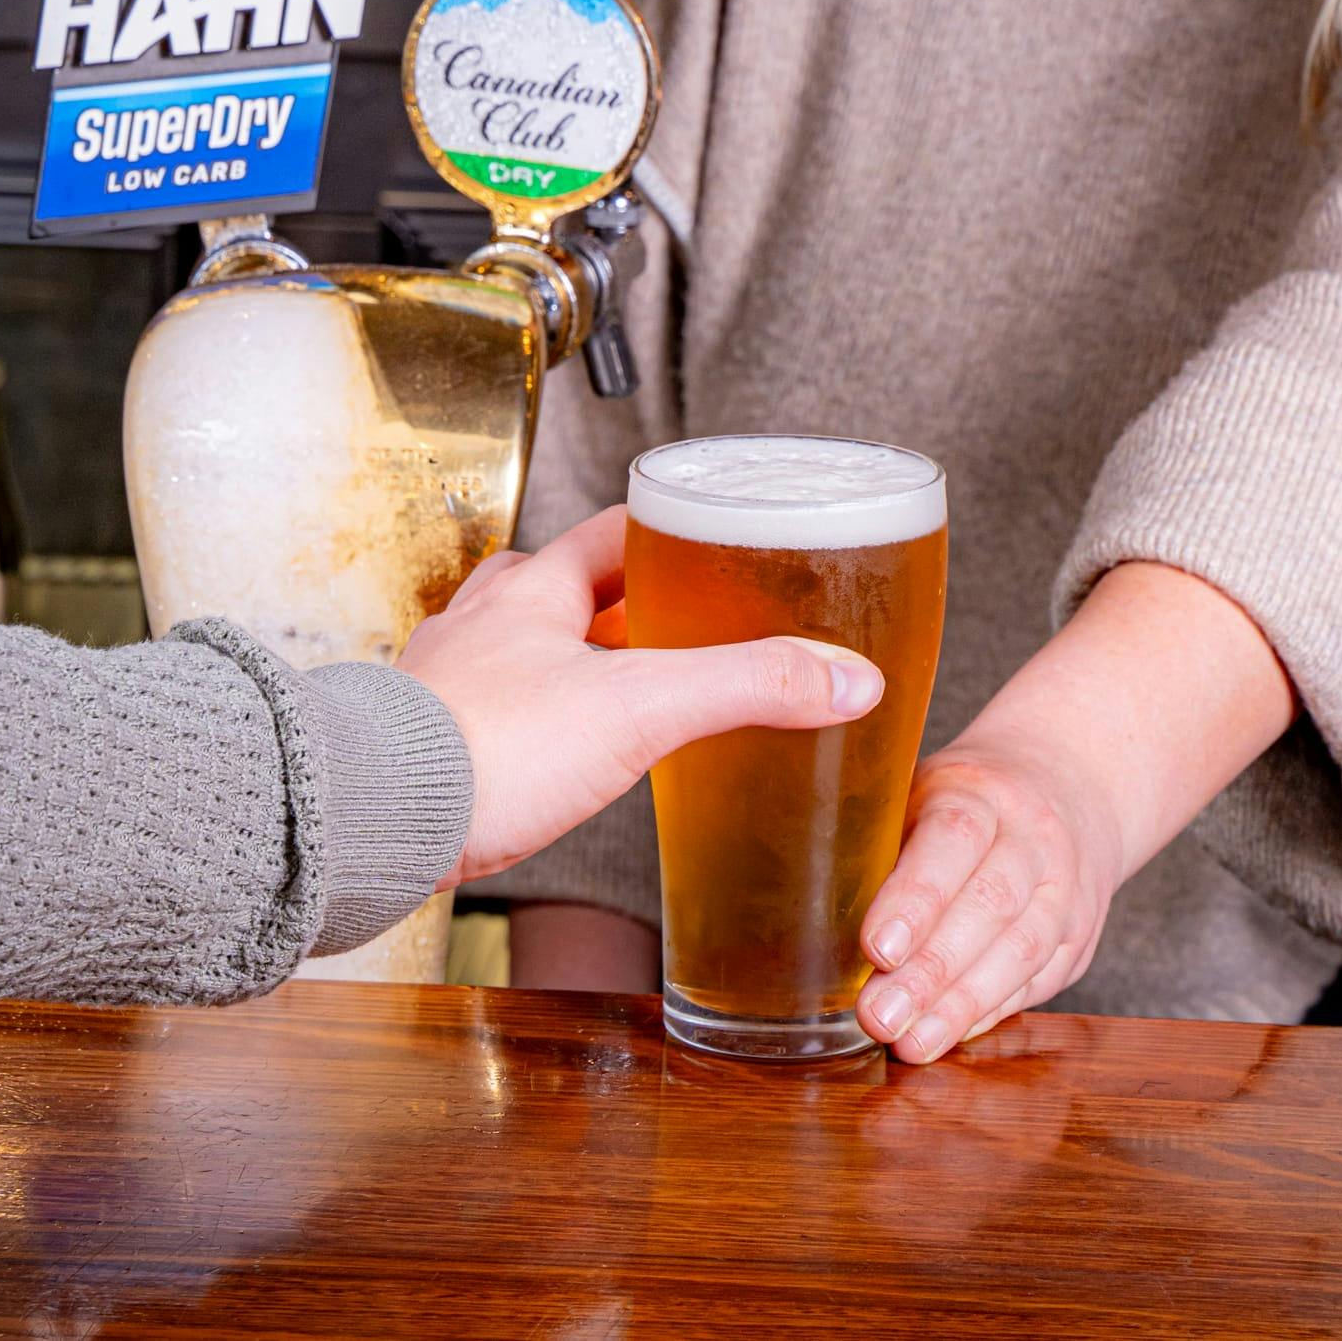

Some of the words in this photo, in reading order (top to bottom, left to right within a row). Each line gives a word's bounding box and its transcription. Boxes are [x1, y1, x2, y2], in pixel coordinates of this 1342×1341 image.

[434, 40, 623, 109] Canadian
[72, 94, 295, 163] SuperDry
[472, 98, 575, 152] Club
[105, 167, 165, 194] LOW
[173, 159, 247, 187] CARB
[489, 161, 556, 189] DRY
